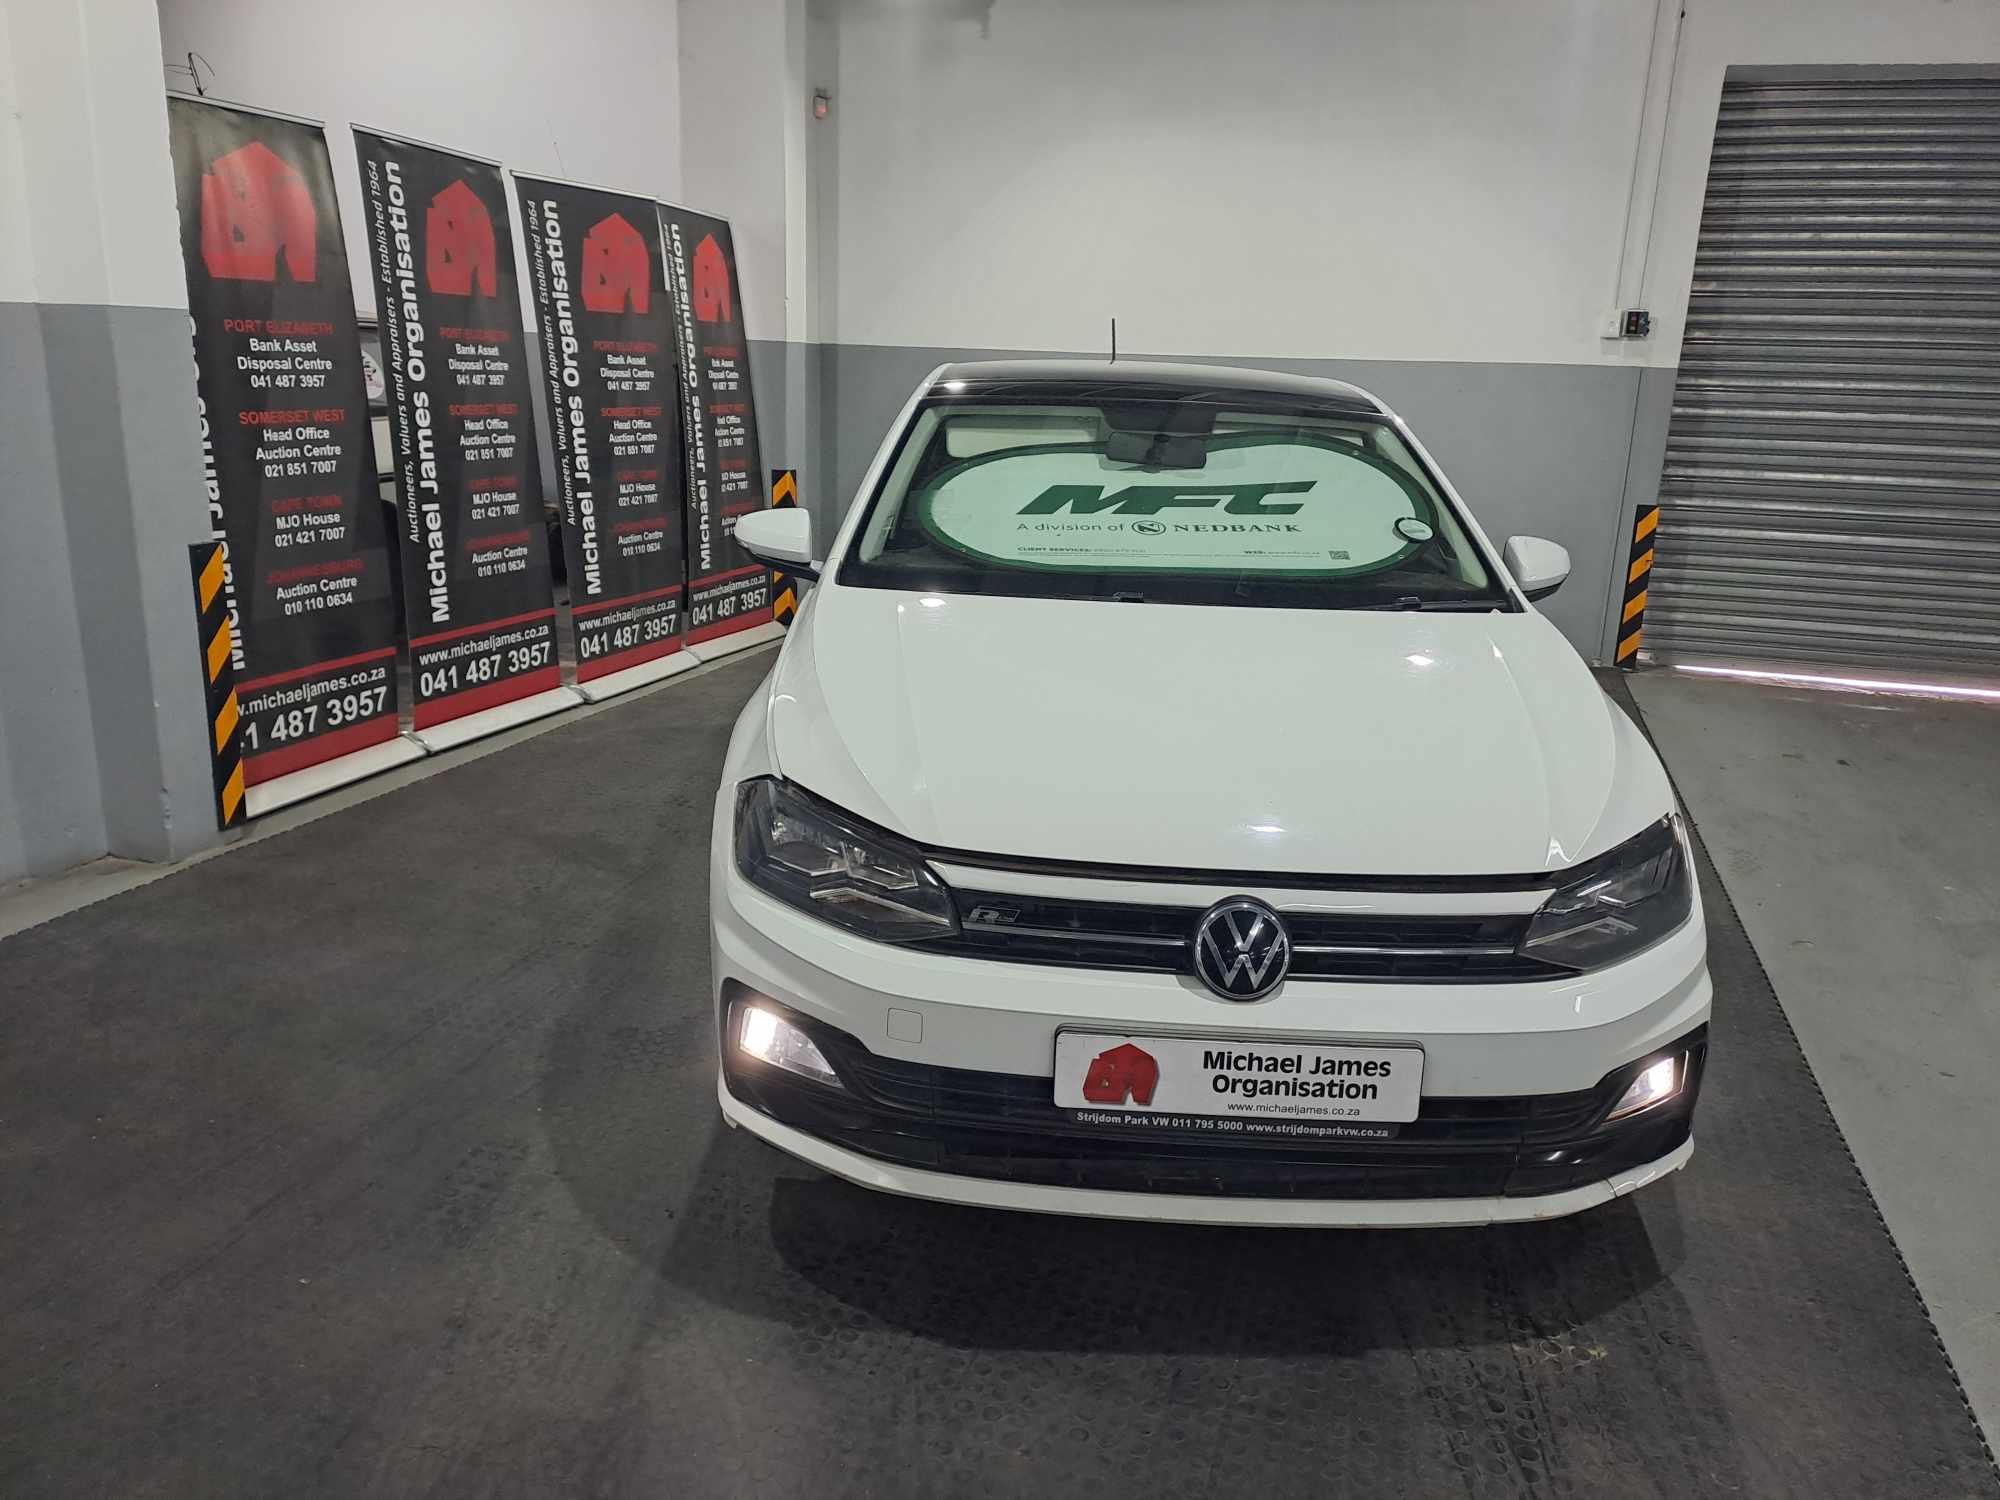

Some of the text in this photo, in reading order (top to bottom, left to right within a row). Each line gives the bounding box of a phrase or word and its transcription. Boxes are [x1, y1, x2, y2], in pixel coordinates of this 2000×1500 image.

[533, 232, 549, 305] Established
[224, 319, 261, 333] PORT
[250, 338, 317, 353] Bank Asset
[367, 160, 420, 543] Auctioneers, Valuers and Appraisers Established 1964
[543, 313, 558, 379] Appraisers
[237, 356, 332, 372] Disposal Centre
[250, 375, 325, 388] 041 487 3957
[385, 161, 450, 623] Michael James Organisation
[543, 200, 601, 595] Michael James Organisation
[671, 223, 711, 570] Michael James Organisation
[314, 408, 345, 422] WEST
[263, 427, 330, 442] Head Office
[460, 435, 490, 446] Auction
[256, 444, 341, 460] Auction Centre
[265, 460, 337, 478] 021 851 7007
[560, 453, 575, 526] Auctioneers,
[1016, 480, 1318, 515] MFC
[276, 513, 341, 529] MJO House
[1017, 521, 1303, 533] A division of NEDBANK
[275, 527, 345, 547] 021 421 7007
[472, 551, 502, 563] Auction
[276, 577, 357, 600] Auction Centre
[284, 592, 353, 615] 010 110 0634
[578, 598, 676, 632] www.michaeljames.co.za
[692, 587, 768, 626] 041 487 3957
[419, 624, 549, 666] www.michaeljames.co.za
[580, 613, 676, 658] 041 487 3957
[420, 641, 550, 697] 041 487 3957
[270, 705, 318, 741] 487
[326, 686, 388, 726] 3957
[1202, 1050, 1392, 1078] Michael James
[1212, 1074, 1378, 1101] Organisation
[1227, 1101, 1361, 1118] www.michaeljames.co.za
[1077, 1111, 1389, 1138] Strijdom Park VW 011 795 5000 www.strijdomparkvw.co.za
